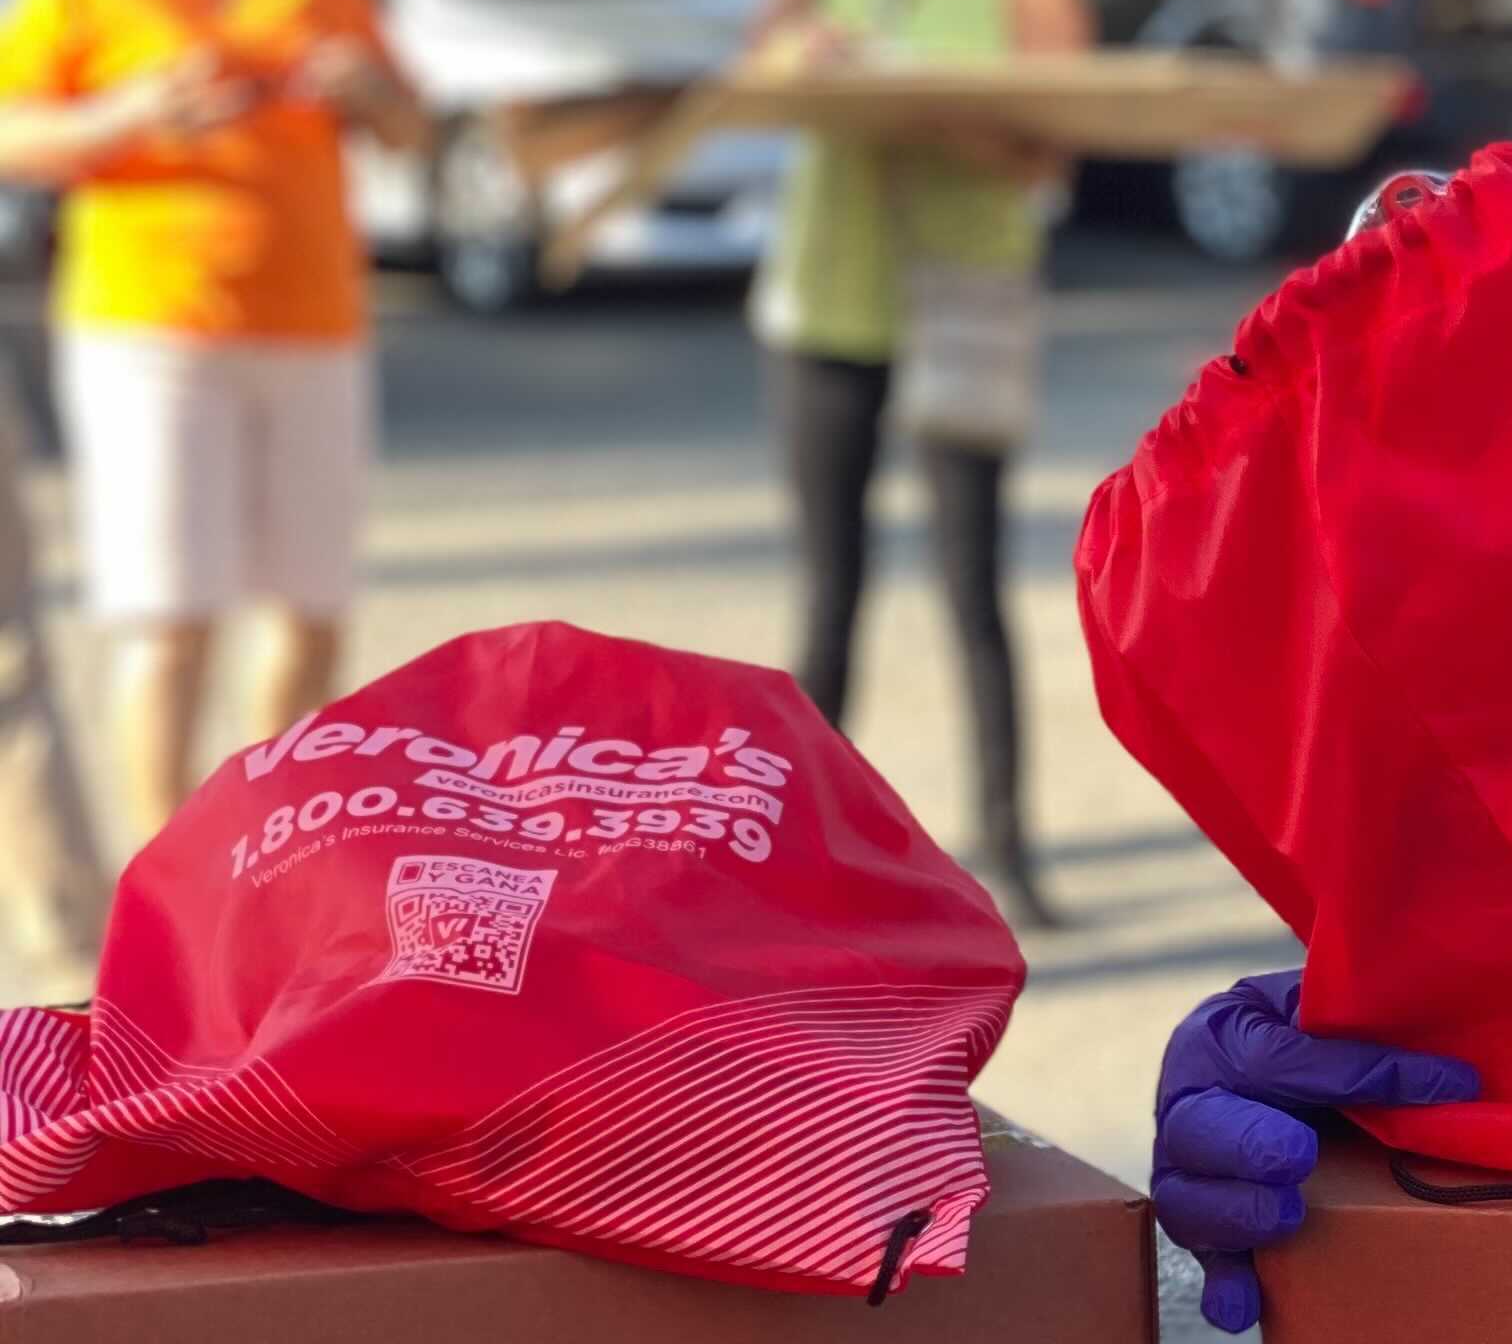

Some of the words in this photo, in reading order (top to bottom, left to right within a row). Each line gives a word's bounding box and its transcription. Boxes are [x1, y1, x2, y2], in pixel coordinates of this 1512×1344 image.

[244, 711, 793, 787] Veronica's
[435, 775, 771, 810] veronicasinsurance.com
[231, 786, 772, 880] 1.800.639.3939
[250, 834, 336, 889] Veronica's
[341, 823, 447, 841] Insurance
[453, 826, 548, 854] Services
[429, 872, 446, 883] Y
[454, 873, 541, 896] GANA
[430, 861, 544, 884] ESCANEA
